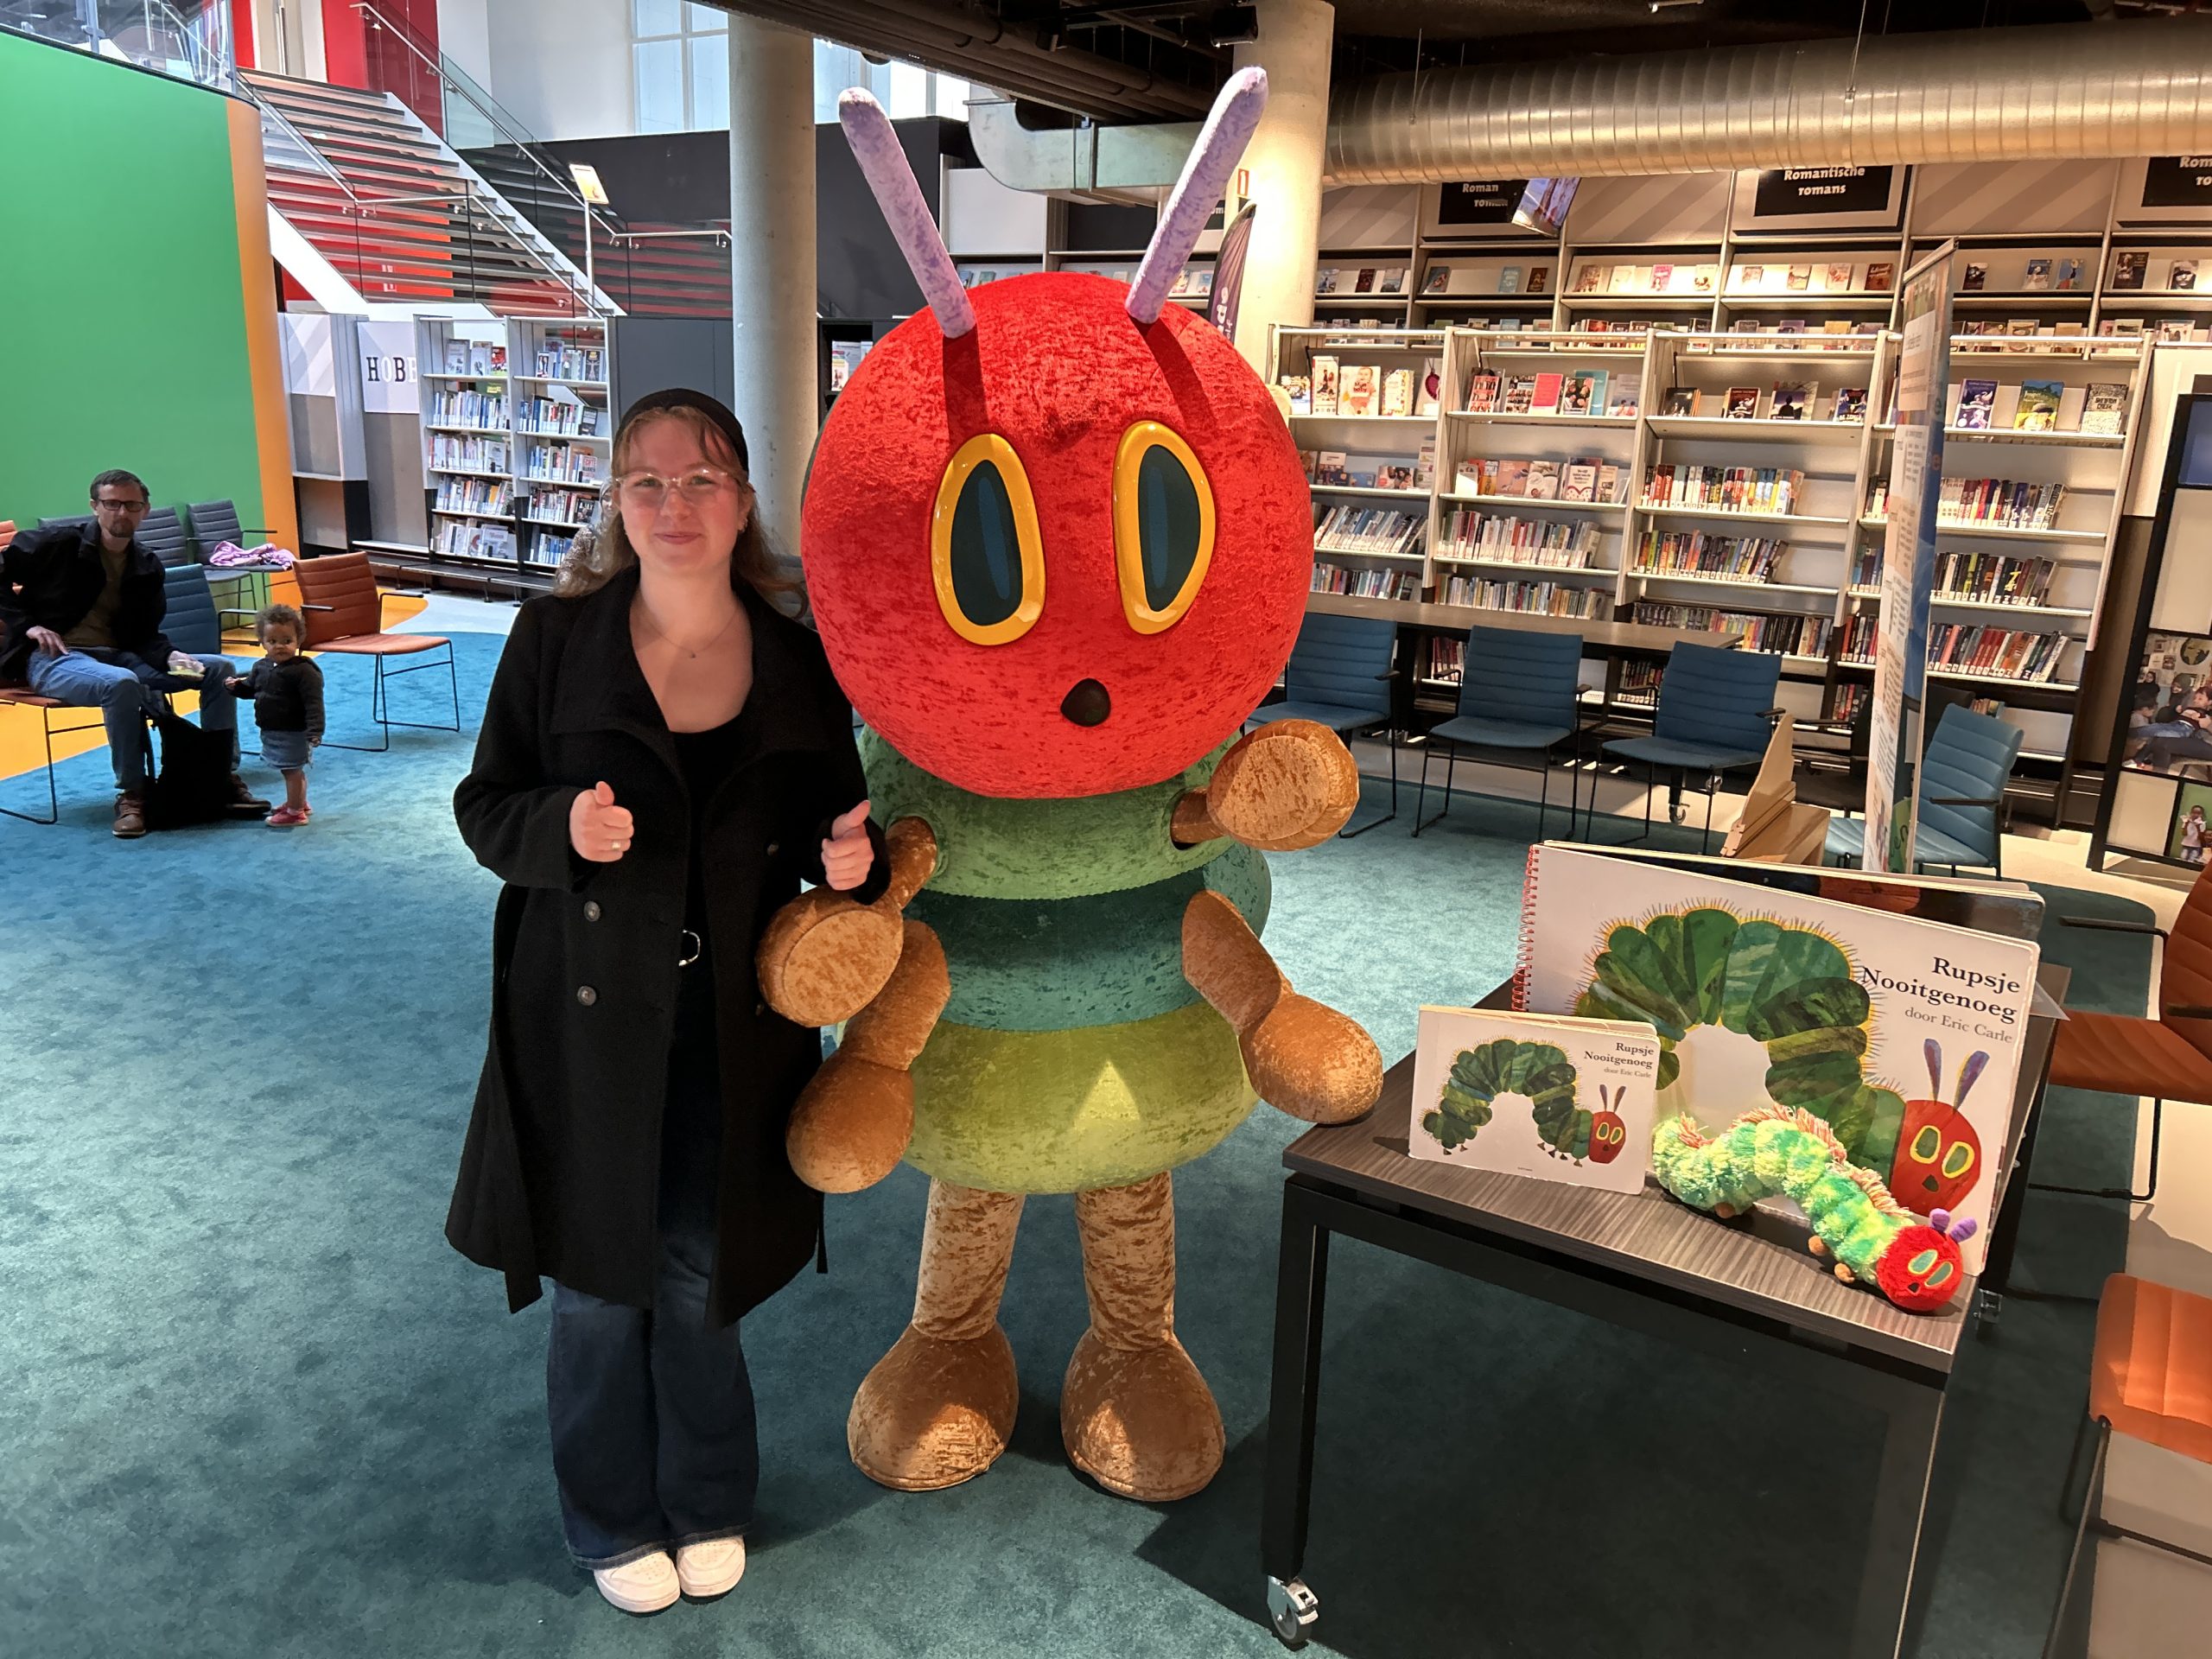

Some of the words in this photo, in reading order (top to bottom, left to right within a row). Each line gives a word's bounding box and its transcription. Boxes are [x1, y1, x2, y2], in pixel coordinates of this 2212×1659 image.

[1783, 167, 1866, 181] Romantische
[1798, 184, 1847, 196] romans
[1931, 957, 2020, 994] Rupsje
[1861, 966, 2018, 1024] Nooitgenoeg
[1904, 1007, 1937, 1023] door
[1941, 1014, 1969, 1032] Eric
[1974, 1024, 2012, 1044] Carle
[1616, 1042, 1655, 1057] Rupsje
[1584, 1051, 1653, 1070] Nooitgenoeg
